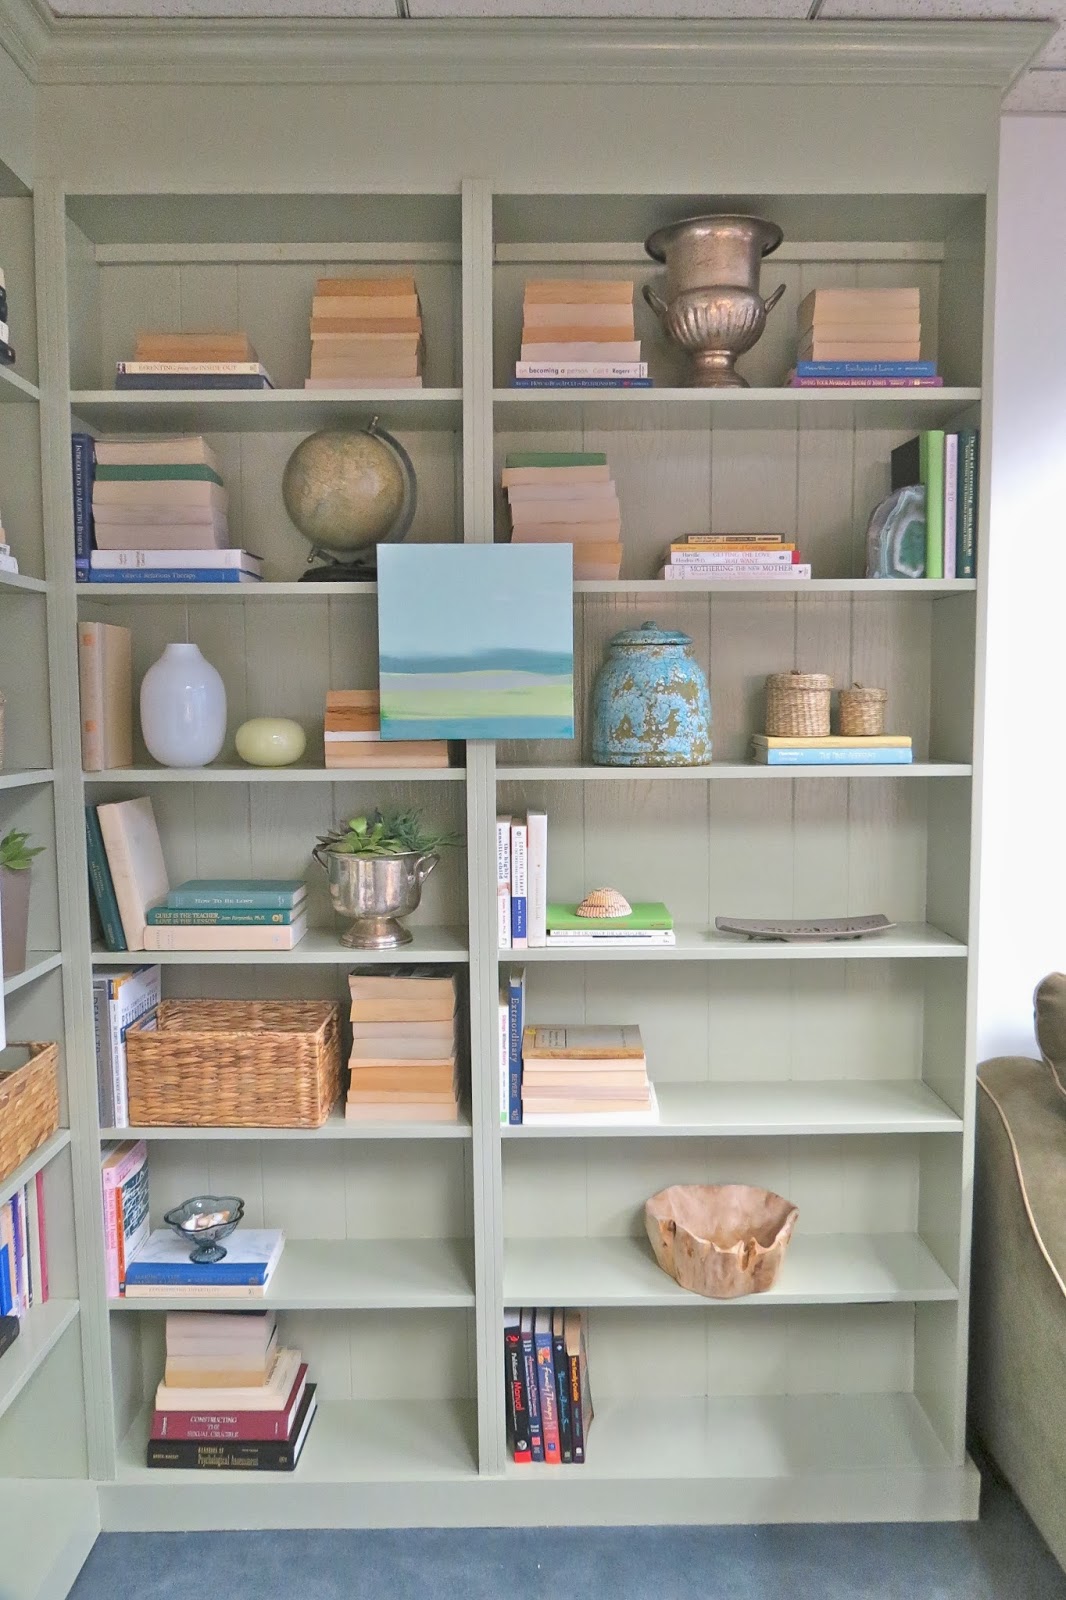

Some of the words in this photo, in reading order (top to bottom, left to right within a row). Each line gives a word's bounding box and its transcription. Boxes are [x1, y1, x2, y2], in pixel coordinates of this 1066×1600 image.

[528, 366, 559, 376] becoming
[612, 367, 630, 376] Rogers
[510, 997, 520, 1063] Extraordinary
[511, 1352, 519, 1381] Publication
[541, 1366, 553, 1391] Family
[571, 1368, 579, 1383] Family
[513, 1381, 525, 1411] Manual
[544, 1391, 554, 1420] Therapy
[198, 1454, 230, 1467] Psychological
[231, 1454, 259, 1466] Assessment
